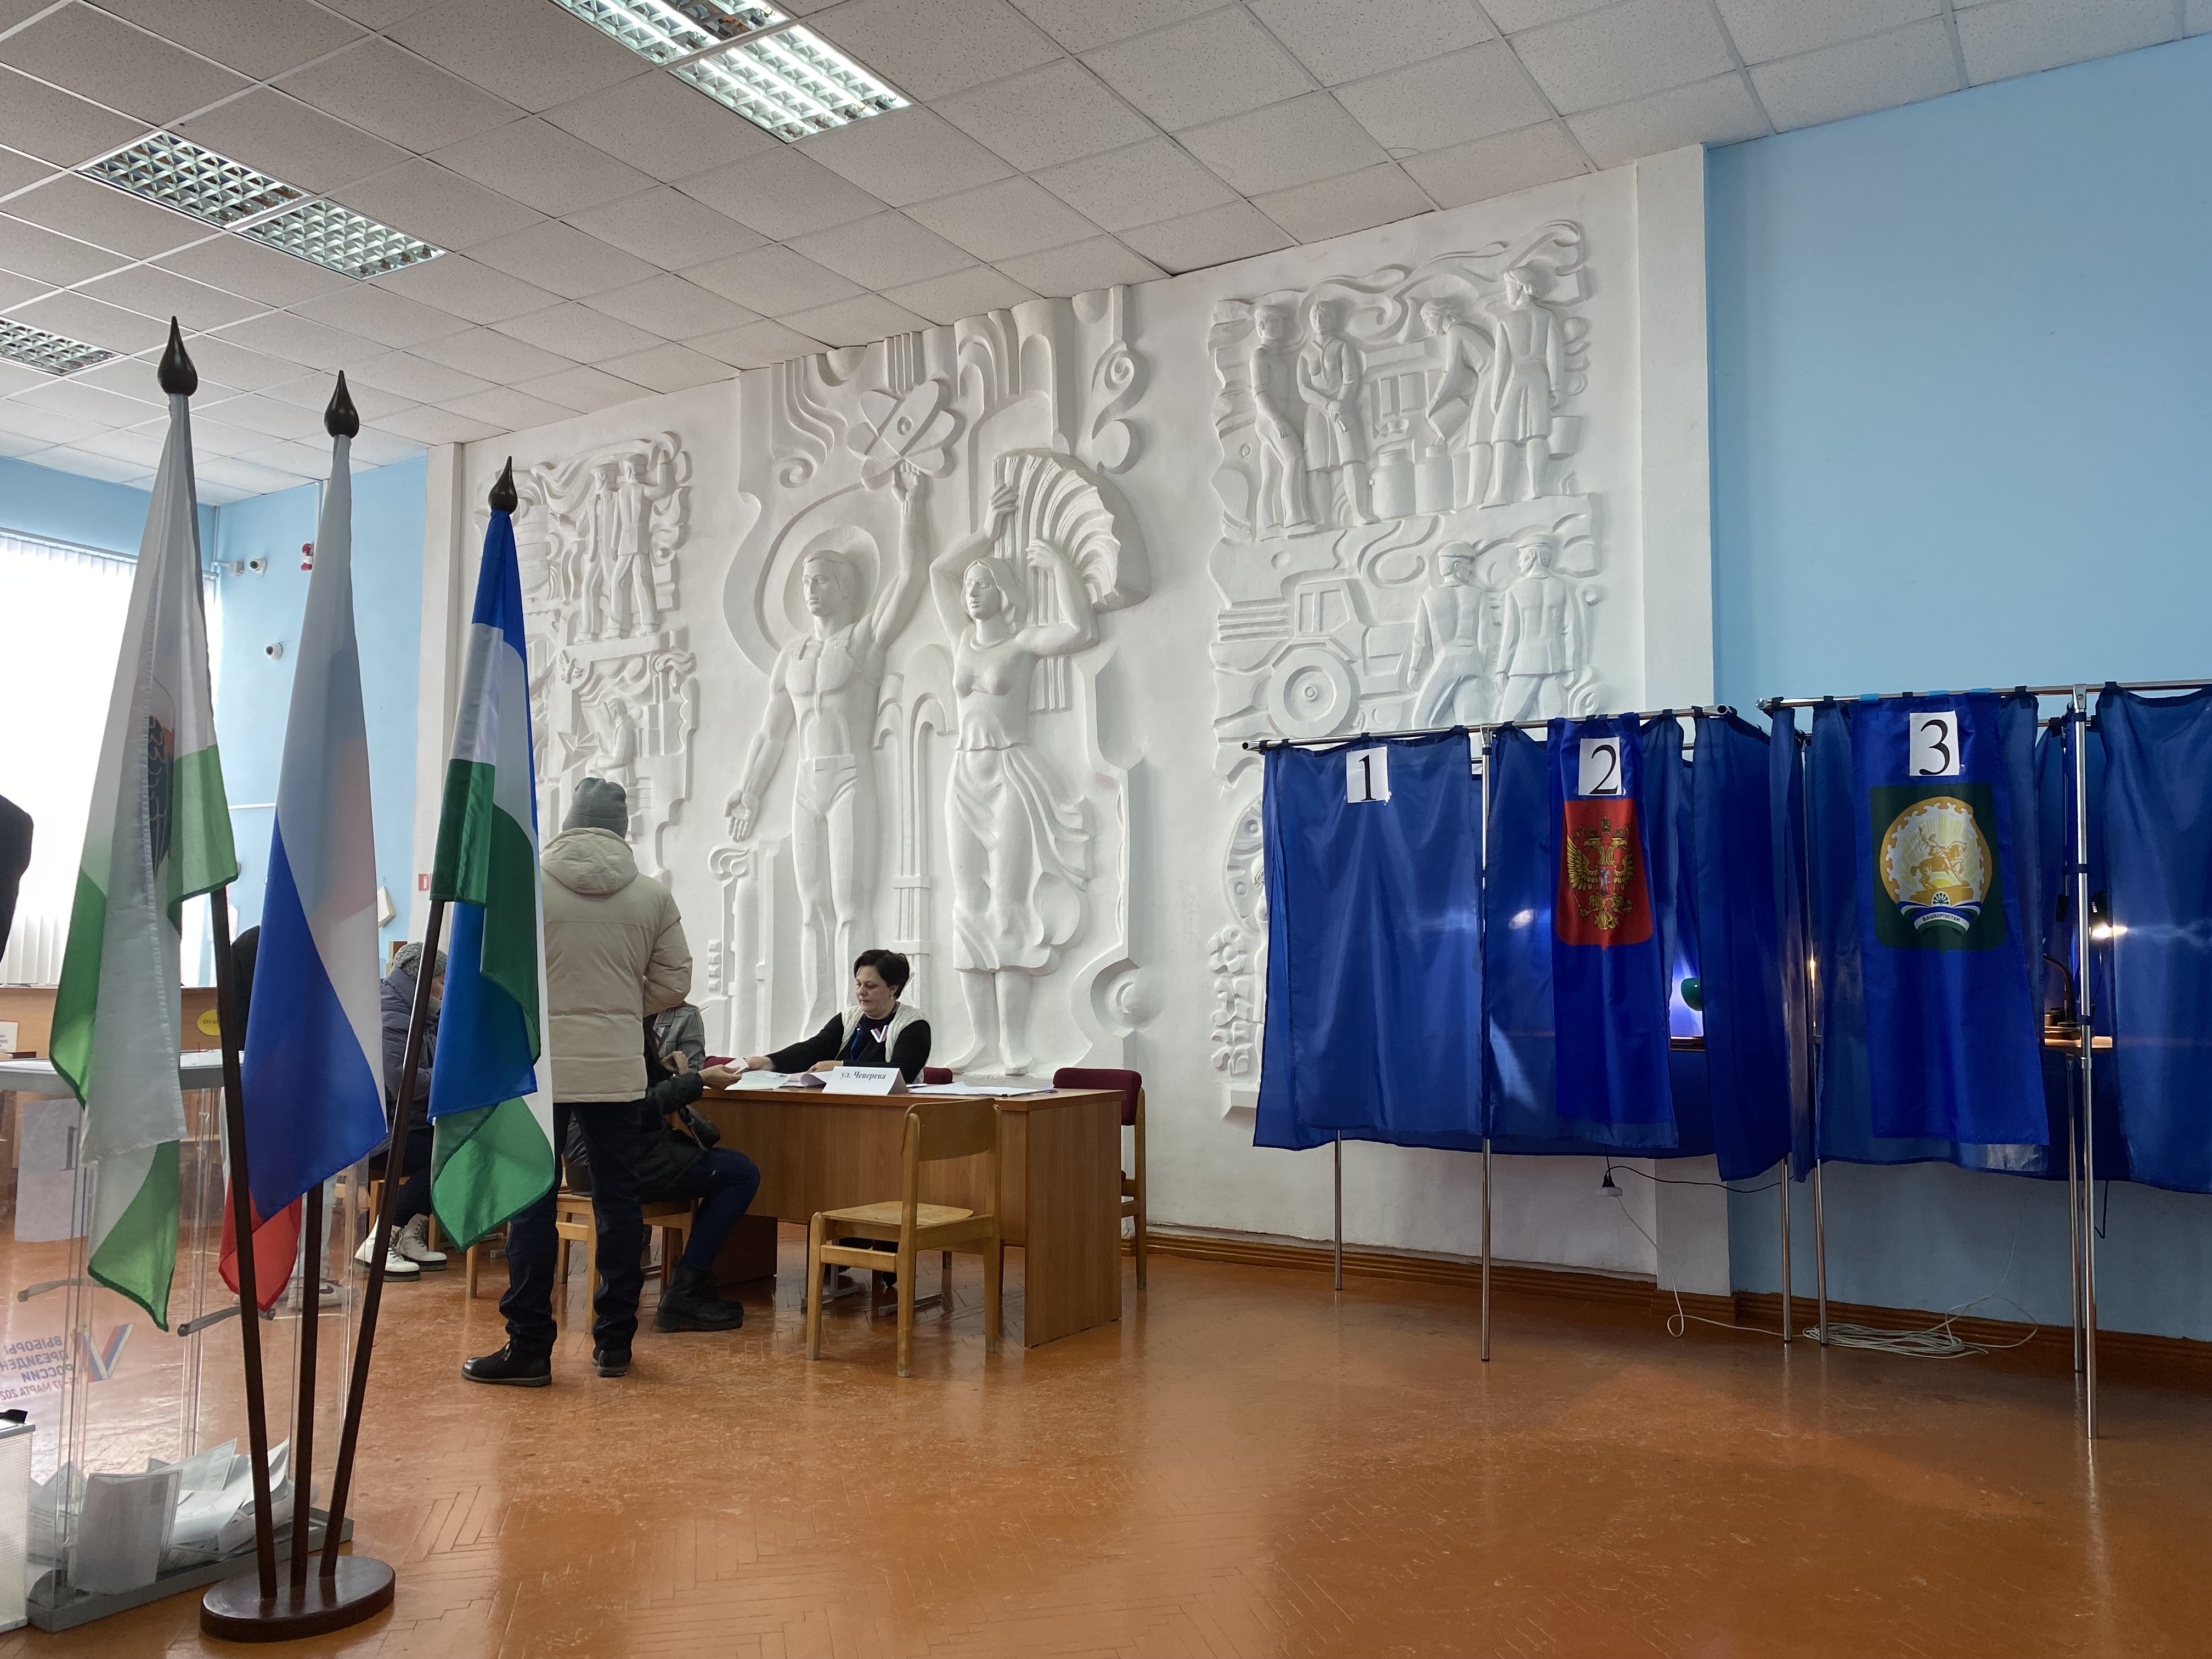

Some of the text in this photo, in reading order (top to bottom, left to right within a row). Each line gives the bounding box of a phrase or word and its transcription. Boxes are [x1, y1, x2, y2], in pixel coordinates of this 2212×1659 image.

[1589, 744, 1618, 794] 2
[1919, 719, 1950, 775] 3
[1358, 754, 1376, 801] 1
[854, 1071, 886, 1081] Чеверева
